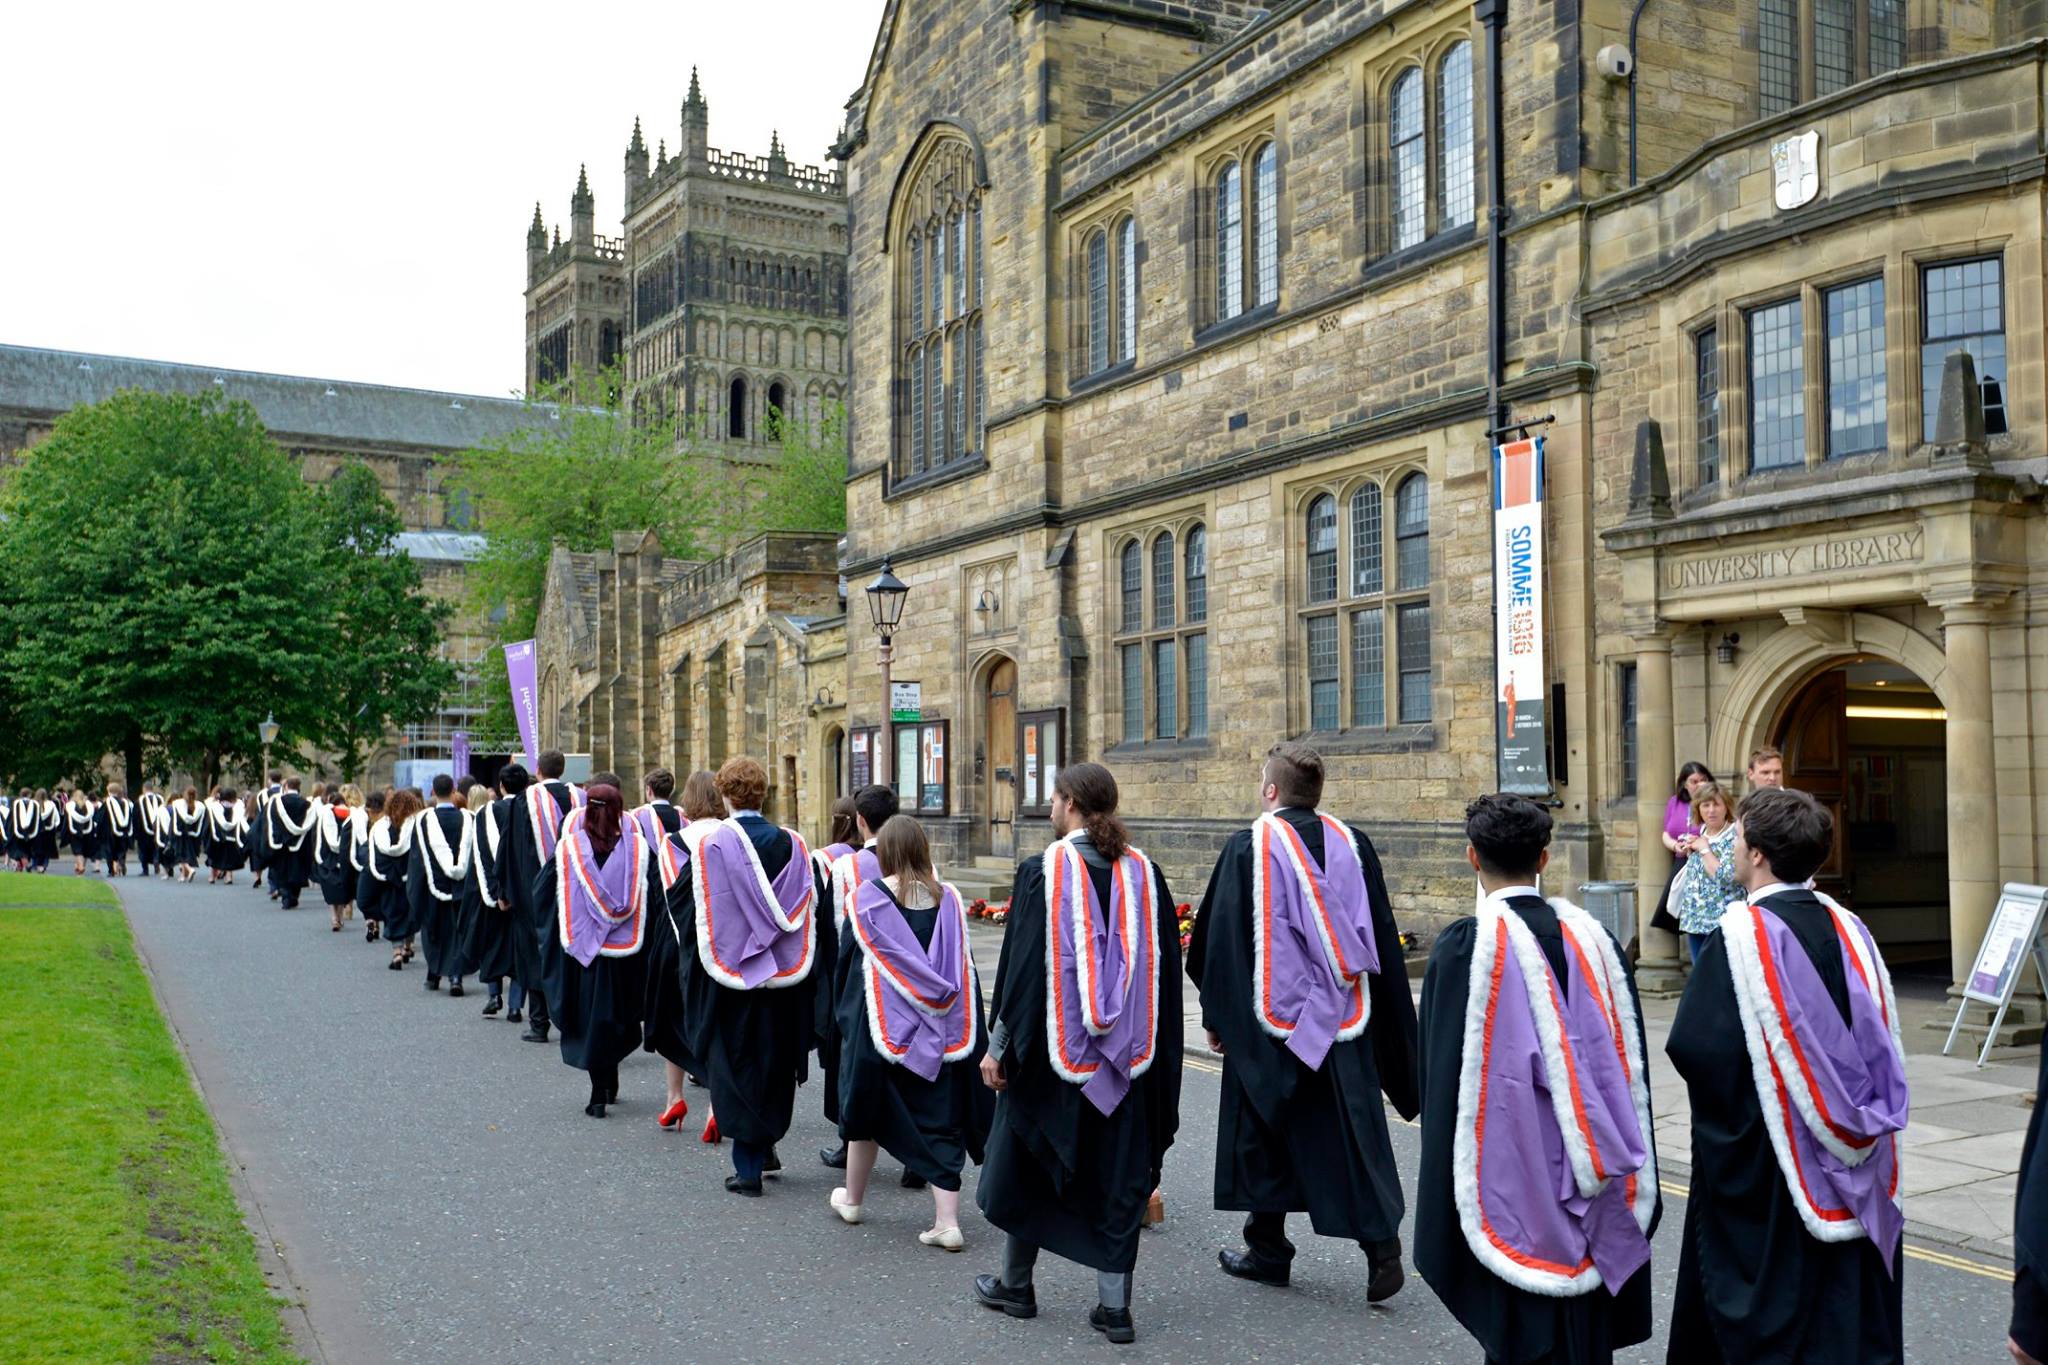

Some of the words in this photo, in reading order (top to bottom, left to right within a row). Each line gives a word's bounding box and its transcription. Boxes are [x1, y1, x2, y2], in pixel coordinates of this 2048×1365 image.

[1511, 525, 1532, 607] SOMME
[1668, 547, 1800, 590] UNIVERSITY
[1812, 529, 1923, 573] LIBRARY
[1512, 609, 1534, 655] 1916
